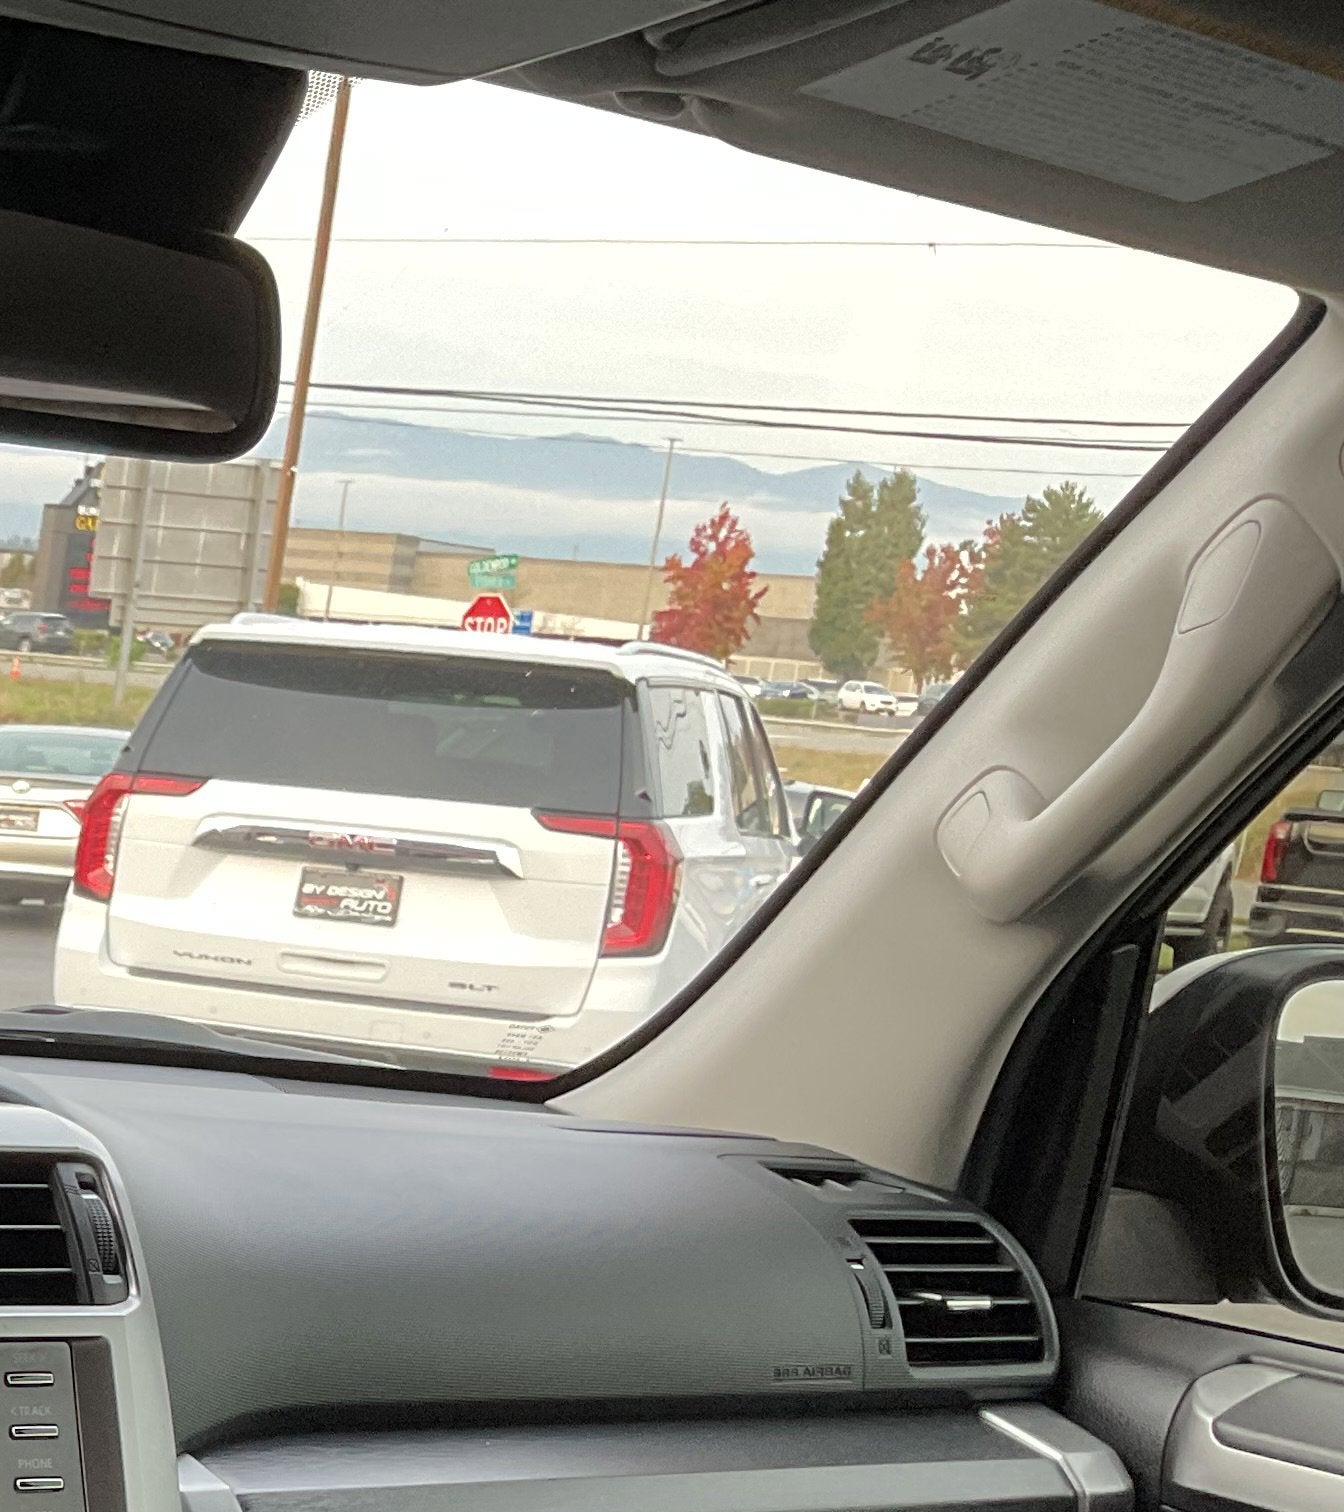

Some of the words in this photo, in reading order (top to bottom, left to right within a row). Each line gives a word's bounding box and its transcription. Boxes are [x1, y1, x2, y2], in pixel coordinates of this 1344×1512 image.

[464, 616, 508, 633] STOP
[308, 831, 397, 852] GMC
[301, 883, 326, 895] BY
[326, 885, 386, 900] DESIGN
[339, 898, 393, 914] AUTO
[173, 949, 253, 966] YUKON
[448, 981, 500, 993] SLT
[803, 1366, 852, 1377] AIRBAG
[18, 1405, 52, 1416] TRACK
[17, 1458, 53, 1469] PHONE
